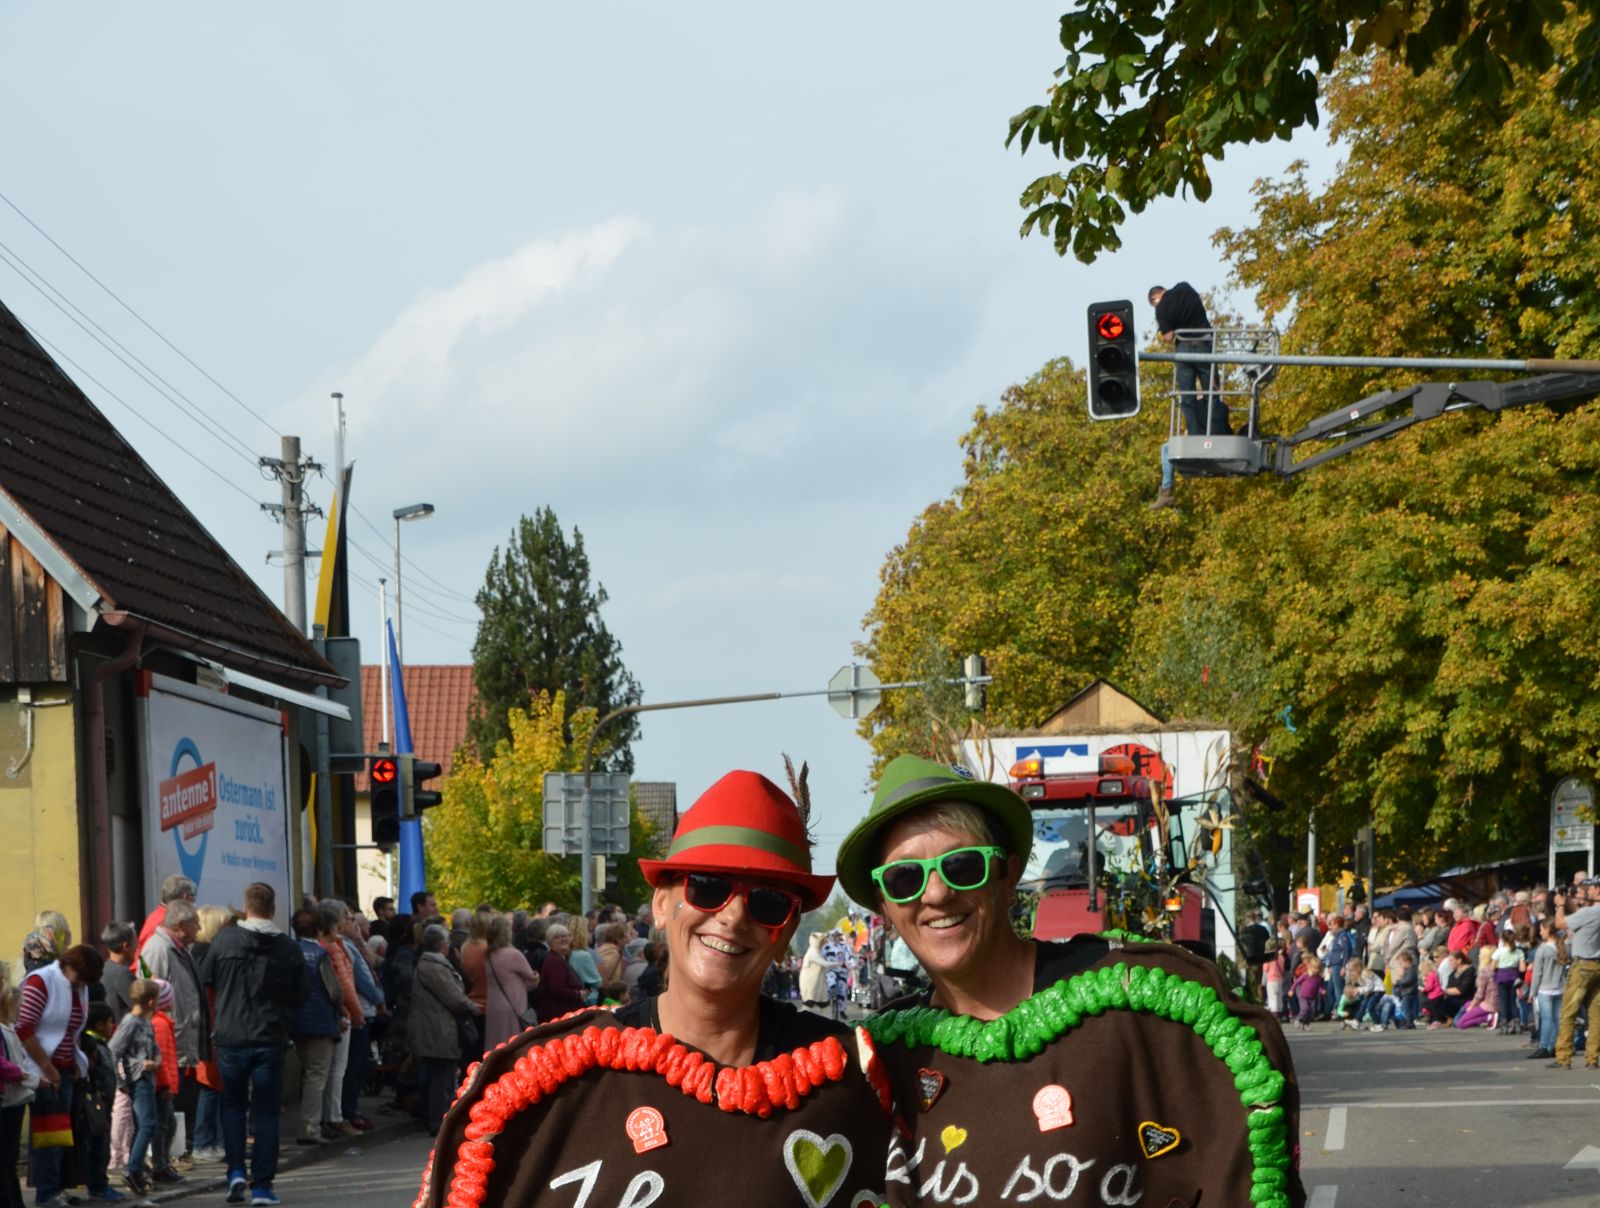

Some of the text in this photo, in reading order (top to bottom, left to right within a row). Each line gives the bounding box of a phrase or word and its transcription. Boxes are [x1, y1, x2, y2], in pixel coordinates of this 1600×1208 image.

[161, 769, 215, 820] antenne 1
[219, 773, 276, 812] Ostermann ist
[234, 813, 264, 844] zurück.
[916, 1158, 980, 1206] is
[1000, 1152, 1097, 1202] so
[1100, 1163, 1144, 1206] a
